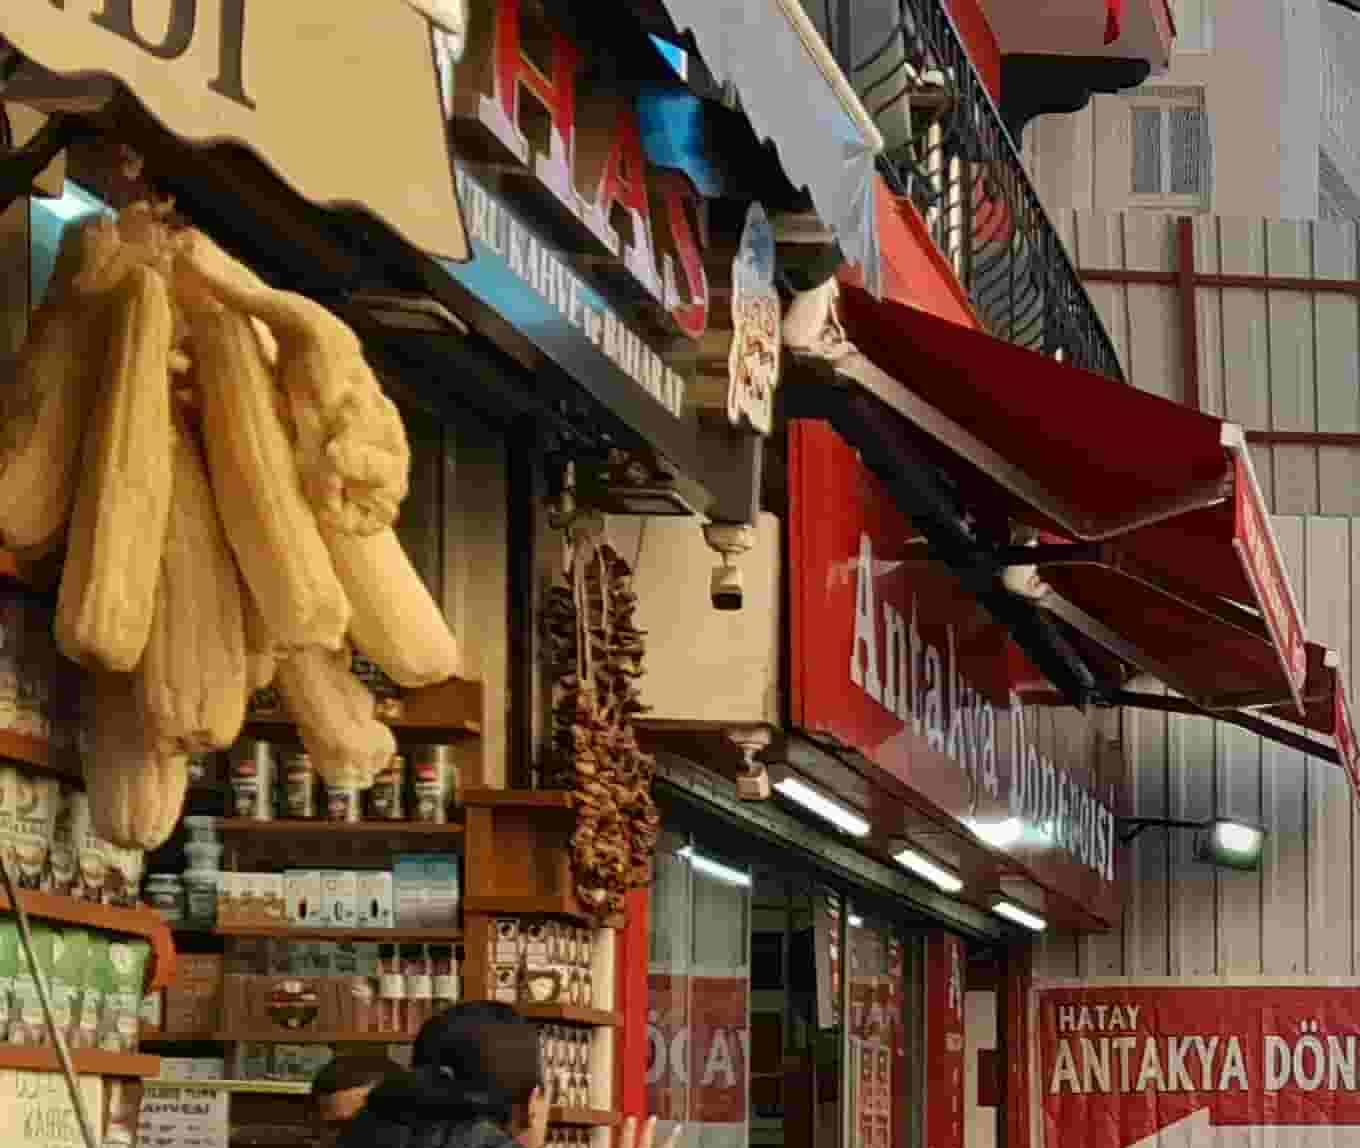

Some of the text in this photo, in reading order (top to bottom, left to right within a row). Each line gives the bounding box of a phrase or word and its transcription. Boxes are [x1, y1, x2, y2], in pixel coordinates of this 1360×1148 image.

[850, 530, 999, 817] Antakya
[1059, 1004, 1141, 1031] HATAY
[1048, 1034, 1249, 1093] ANTAKYA
